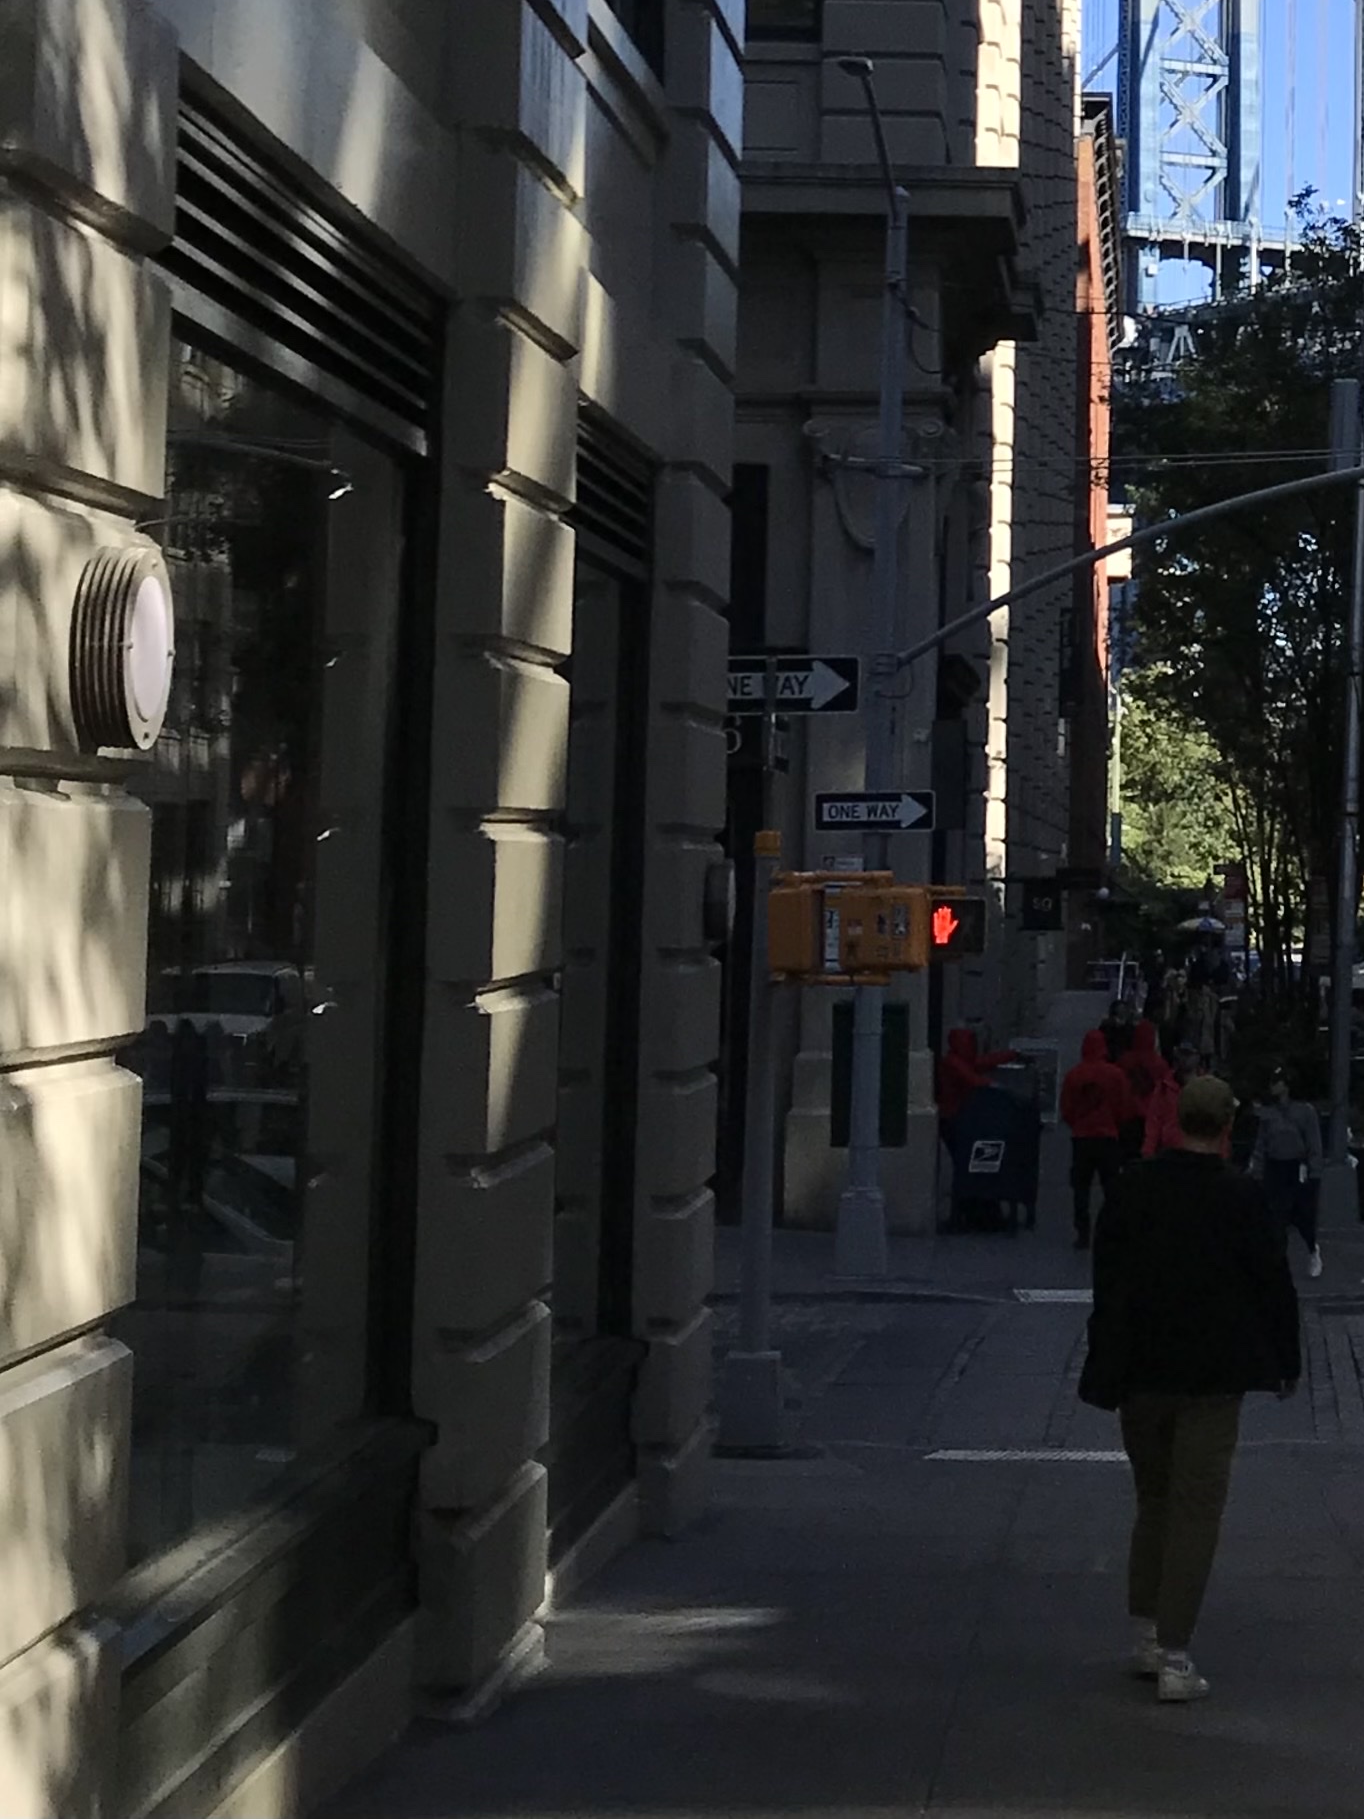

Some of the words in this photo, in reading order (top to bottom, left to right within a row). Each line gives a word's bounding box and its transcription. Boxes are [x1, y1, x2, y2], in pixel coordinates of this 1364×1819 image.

[727, 675, 753, 697] NE
[828, 804, 861, 819] ONE
[866, 804, 899, 819] WAY
